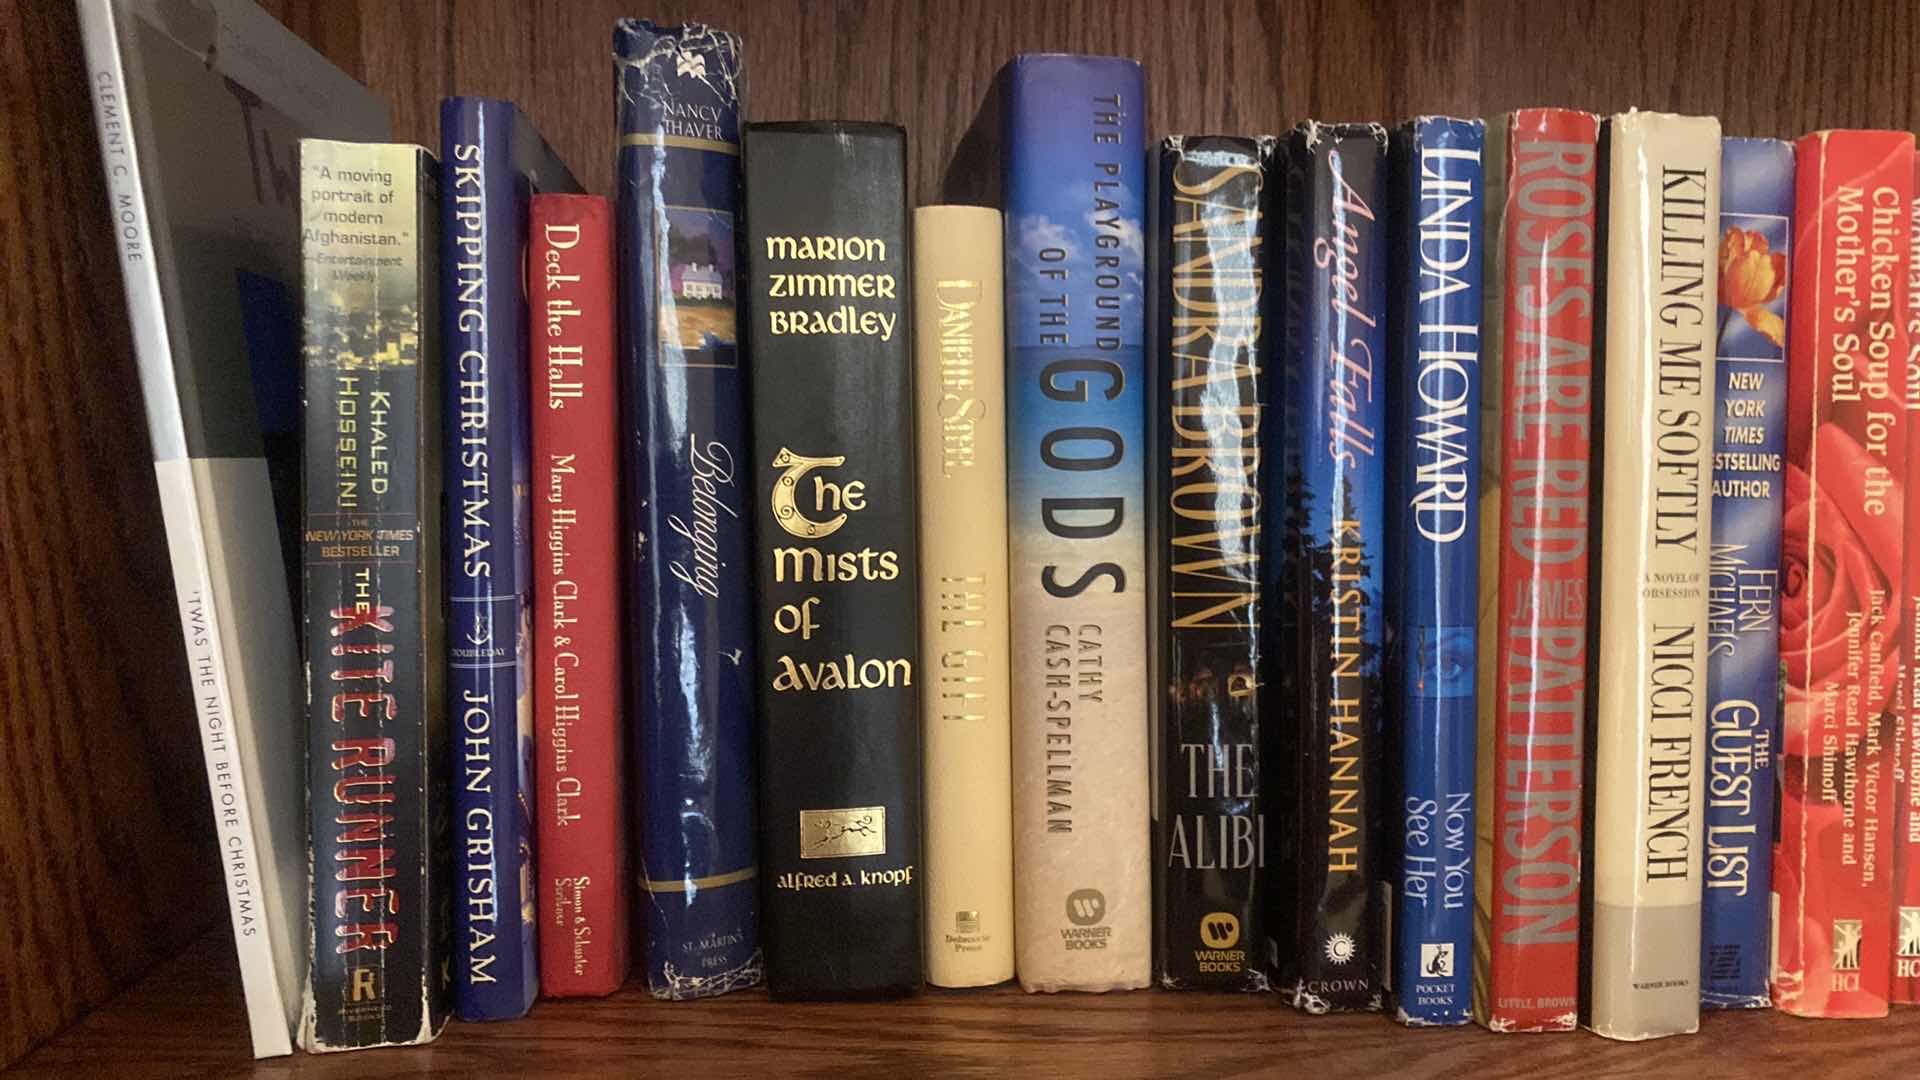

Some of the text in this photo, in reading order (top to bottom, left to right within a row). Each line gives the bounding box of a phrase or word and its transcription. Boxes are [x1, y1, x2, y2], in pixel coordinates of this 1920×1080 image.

[663, 103, 721, 122] NANCY
[97, 71, 142, 261] CLEMENT C. MOORE
[338, 170, 392, 186] moving
[311, 190, 395, 204] portrait of
[323, 211, 384, 224] modern
[1093, 94, 1122, 350] THE PLAYGROUND
[545, 224, 583, 411] Deck the Halls
[1040, 248, 1069, 344] OF THE
[1314, 150, 1376, 469] Angel Falls
[1832, 185, 1864, 402] Mother's Soul
[454, 143, 490, 578] SKIPPING CHRISTMAS
[1410, 143, 1480, 543] LINDA HOWARD
[1511, 140, 1593, 565] ROSES ARE RED
[1655, 167, 1707, 552] KILLING ME SOFTLY
[1860, 187, 1901, 516] Chicken Soup for the
[1172, 164, 1262, 629] SANDRA BROWN
[1725, 400, 1766, 417] YORK
[1728, 372, 1764, 391] NEW
[339, 377, 359, 507] HOSSEINI
[371, 391, 390, 495] KHALED
[1712, 454, 1781, 472] STSELLING
[1724, 427, 1765, 445] TIMES
[1039, 359, 1126, 599] GODS
[1712, 480, 1771, 498] AUTHOR
[306, 529, 414, 542] NEW YORK TIMES
[352, 519, 368, 528] THE
[668, 433, 737, 599] Belonging
[321, 545, 400, 558] BESTSELLER
[1653, 572, 1688, 583] NOVEL
[355, 568, 370, 614] THE
[774, 597, 821, 640] of
[941, 574, 986, 632] THE
[1511, 579, 1585, 620] JAMES
[1642, 588, 1700, 599] OBSESSION
[1738, 568, 1777, 633] FERN
[330, 605, 396, 723] KITE
[549, 453, 581, 827] Mary Higgins Clark & Carol Higgins Clark
[1078, 624, 1103, 703] CATHY
[198, 653, 215, 688] THE
[1328, 519, 1361, 873] KRISTIN HANNAH
[205, 697, 226, 754] NIGHT
[1045, 624, 1072, 833] CASH-SPELLMAN
[1647, 623, 1695, 883] NICCI FRENCH
[1754, 730, 1770, 769] THE
[1822, 682, 1840, 803] Marci Shimoff
[1843, 611, 1863, 865] Jennifer Read Hawthorne and
[1861, 589, 1885, 887] Jack Canfield, Mark Victor Hansen,
[1181, 744, 1259, 798] THE
[1503, 626, 1587, 944] PATTERSON
[1709, 699, 1760, 816] GUEST
[216, 760, 238, 827] BEFORE
[330, 737, 400, 954] RUNNER
[464, 689, 497, 984] JOHN GRISHAM
[1169, 814, 1265, 870] ALIBI
[1405, 796, 1437, 908] See Her
[1707, 824, 1757, 898] LIST
[228, 836, 256, 938] CHRISTMAS
[573, 876, 590, 912] Simon
[574, 927, 591, 975] Schuster
[1061, 927, 1112, 938] WARNER
[1065, 939, 1107, 950] BOOKS
[1195, 951, 1245, 961] WARNER
[1200, 962, 1241, 972] BOOKS
[1308, 979, 1369, 994] CROWN
[1416, 984, 1454, 993] POCKET
[1831, 973, 1859, 992] HCI
[1897, 959, 1920, 977] HC
[1418, 996, 1453, 1005] BOOKS
[1536, 997, 1576, 1008] BROWN
